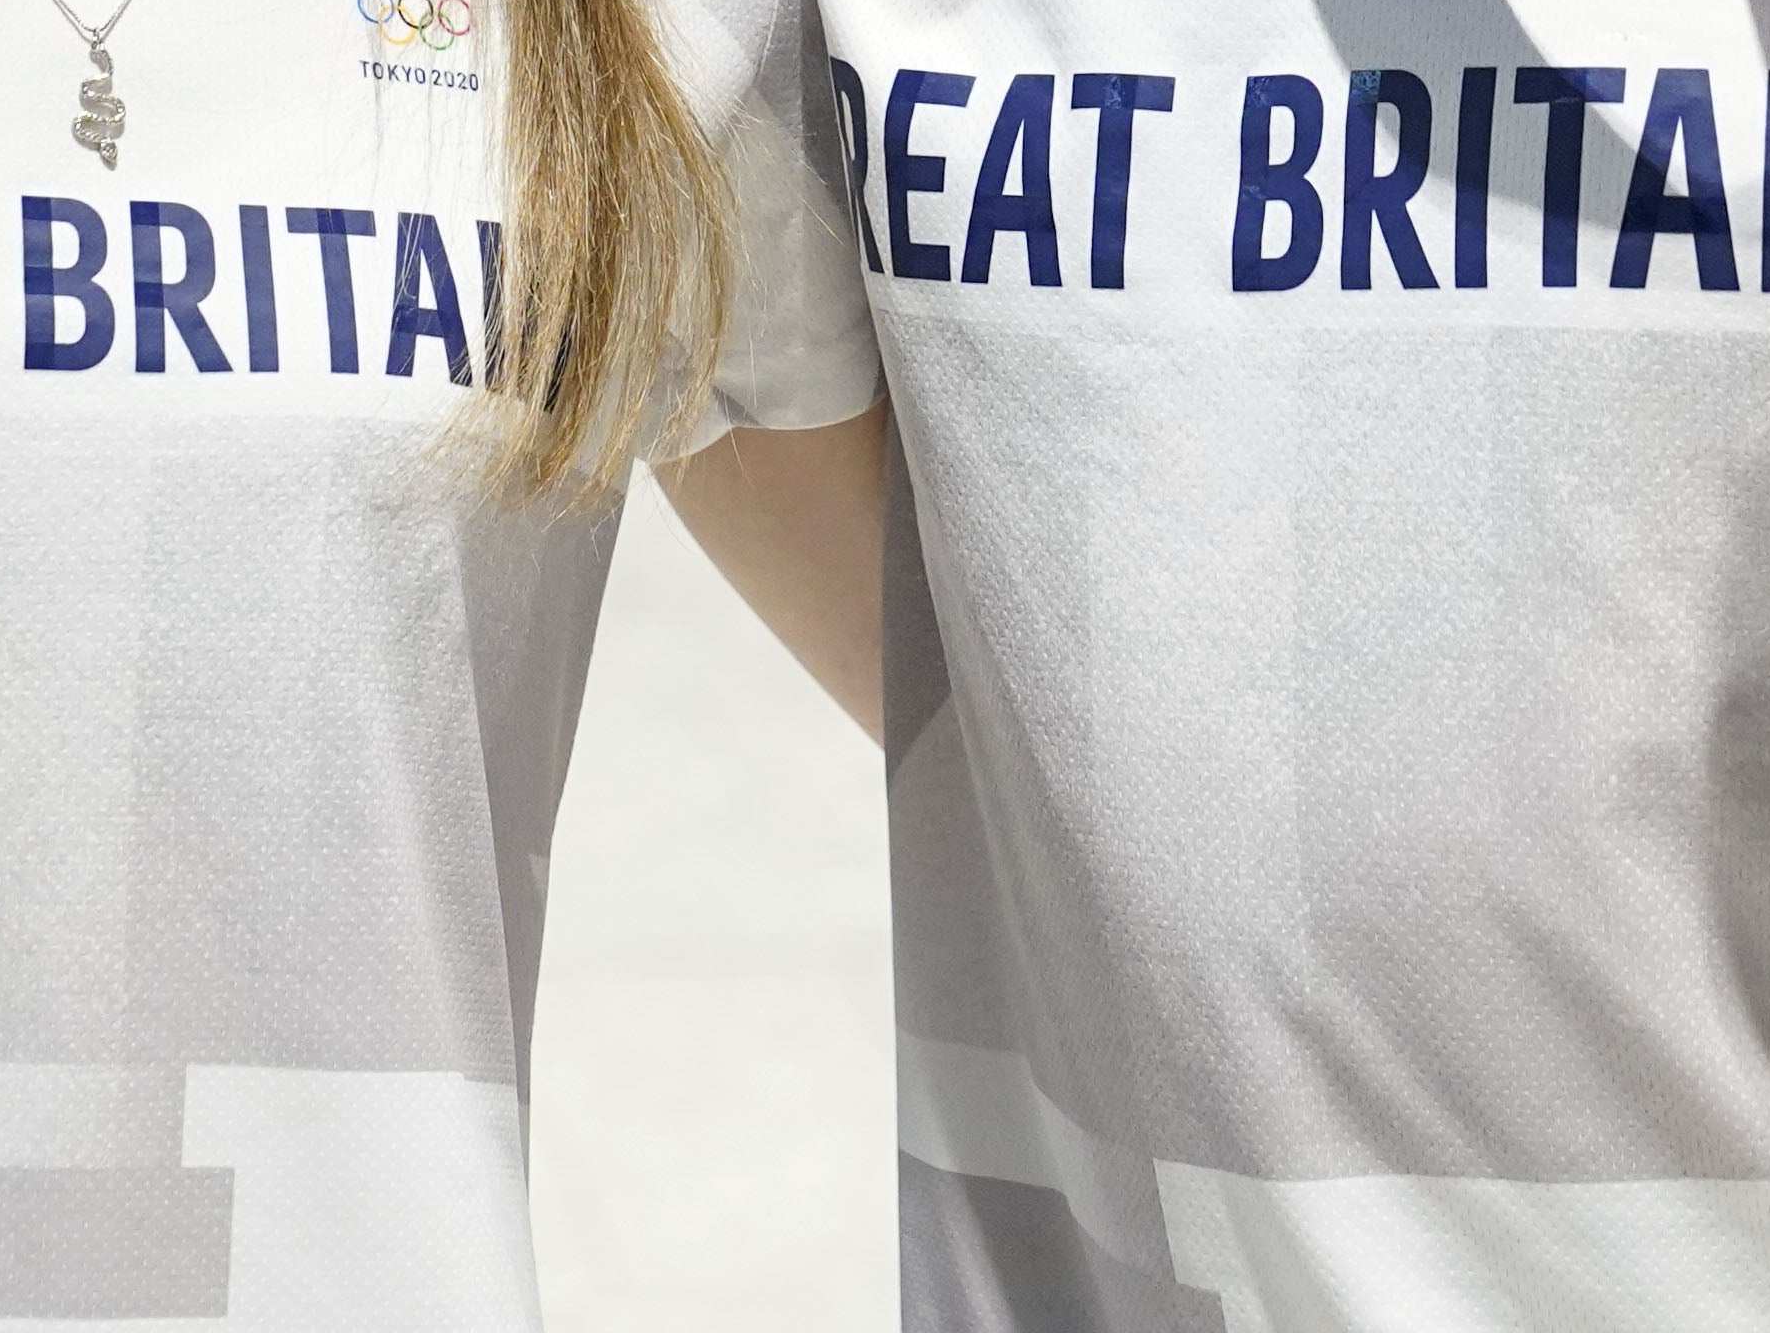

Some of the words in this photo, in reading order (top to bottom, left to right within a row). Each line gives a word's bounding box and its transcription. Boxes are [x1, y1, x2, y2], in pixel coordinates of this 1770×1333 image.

[359, 60, 426, 85] TOKYO
[432, 69, 479, 91] 2020
[830, 55, 1175, 290] REAT
[21, 195, 575, 411] BRITAI
